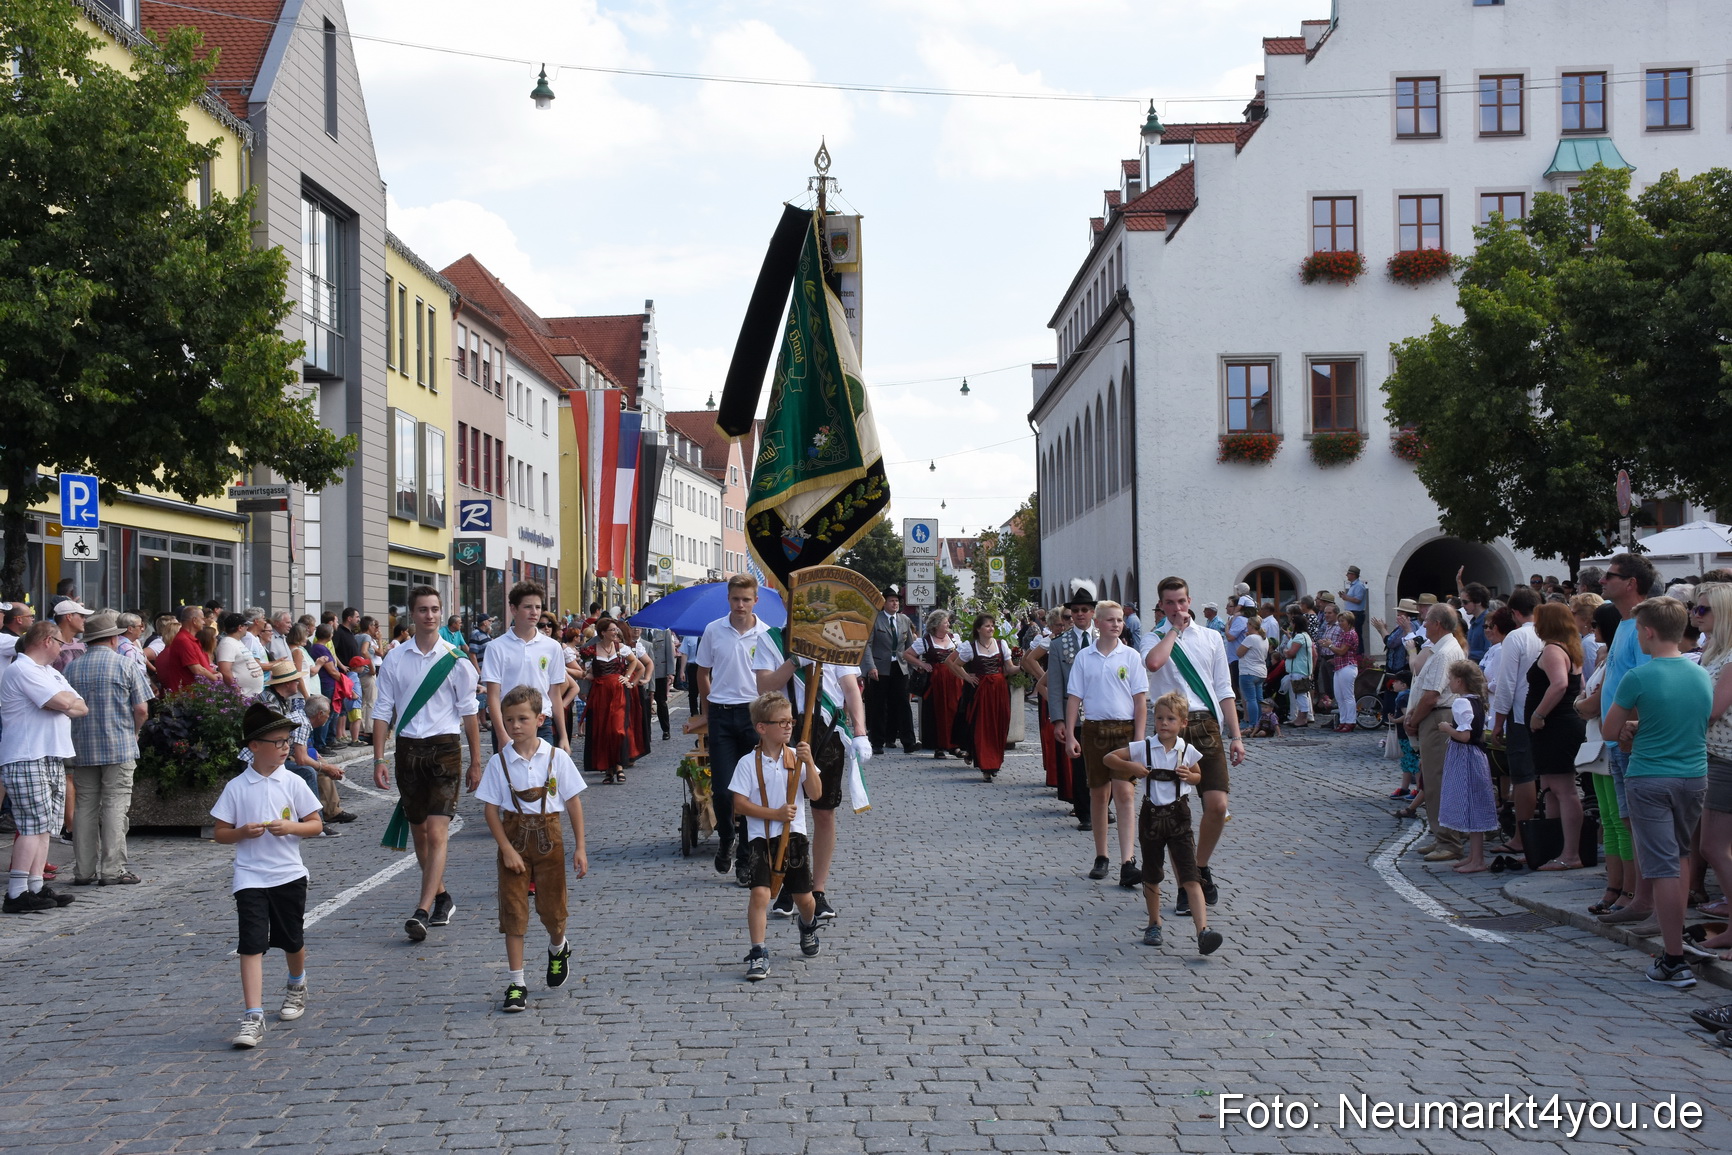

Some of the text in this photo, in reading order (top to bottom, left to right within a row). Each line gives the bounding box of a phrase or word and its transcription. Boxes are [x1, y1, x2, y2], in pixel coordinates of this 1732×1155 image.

[229, 487, 285, 496] Brunnwirtsgasse
[69, 480, 90, 520] P
[912, 546, 930, 554] ZONE
